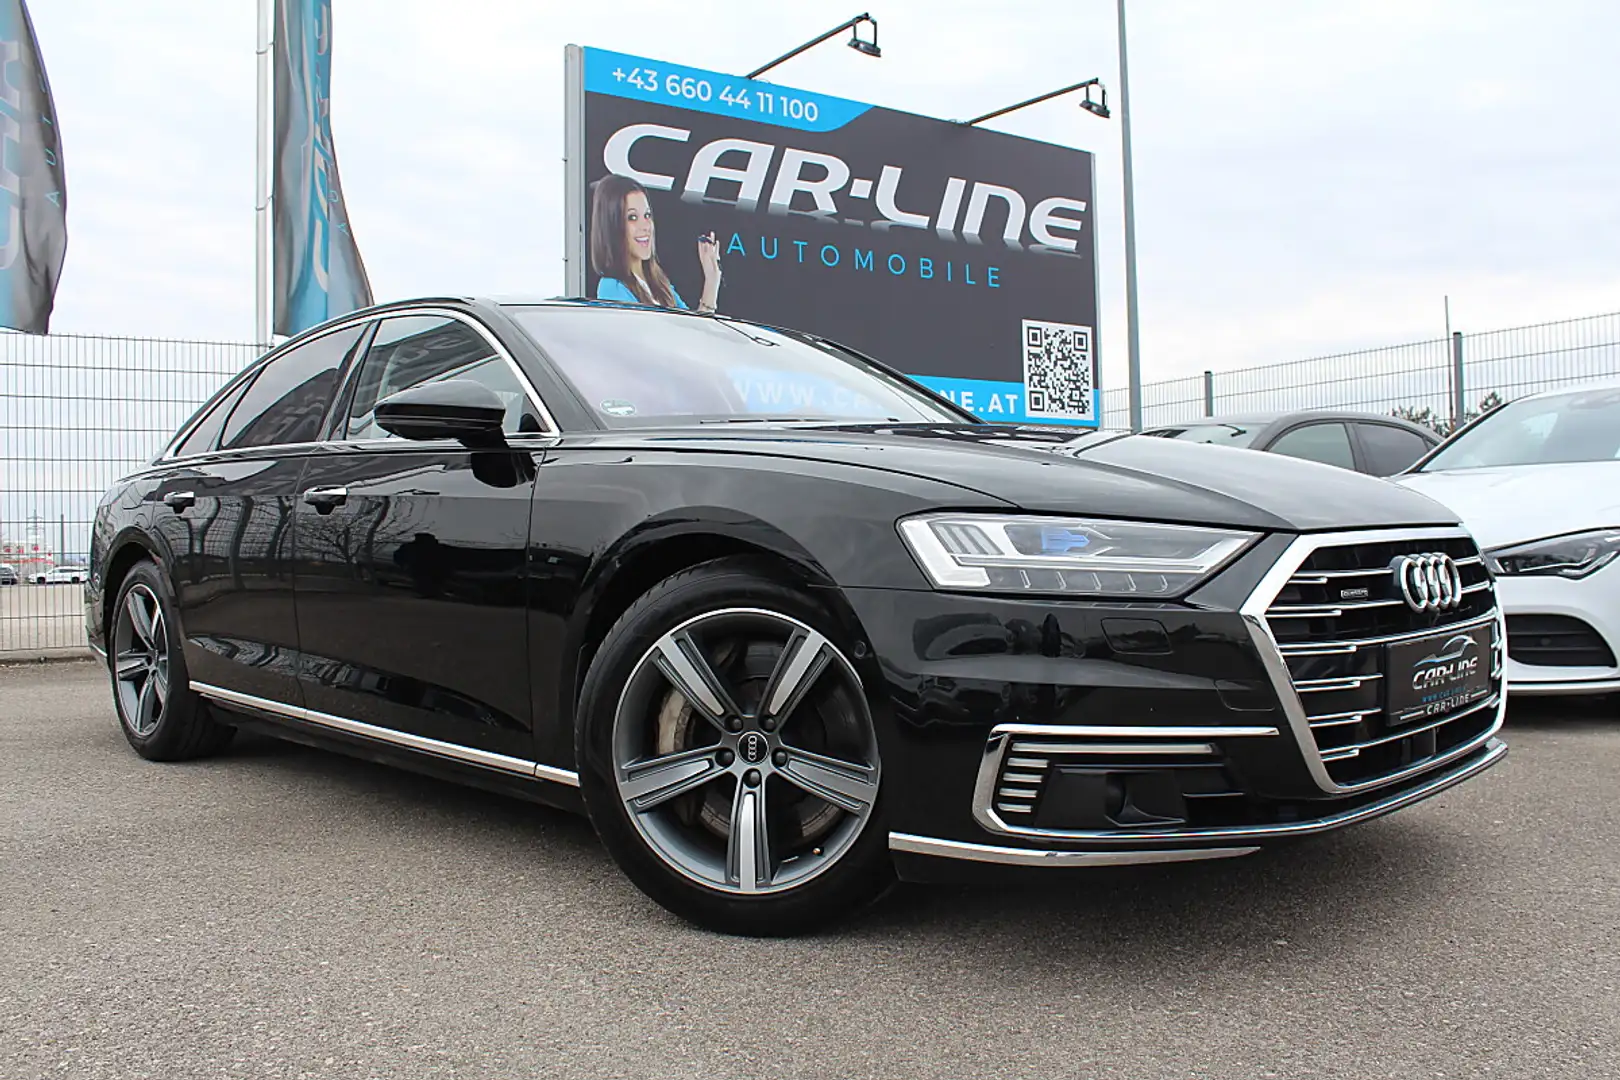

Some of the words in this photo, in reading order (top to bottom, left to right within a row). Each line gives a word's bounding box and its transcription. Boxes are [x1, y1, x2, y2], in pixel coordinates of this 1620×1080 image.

[612, 67, 658, 91] +43
[666, 75, 712, 101] 660
[719, 85, 751, 109] 44
[756, 92, 775, 113] 11
[780, 96, 819, 122] 100
[603, 123, 1088, 252] CAR-LINE
[727, 232, 1001, 288] AUTOMOBILE
